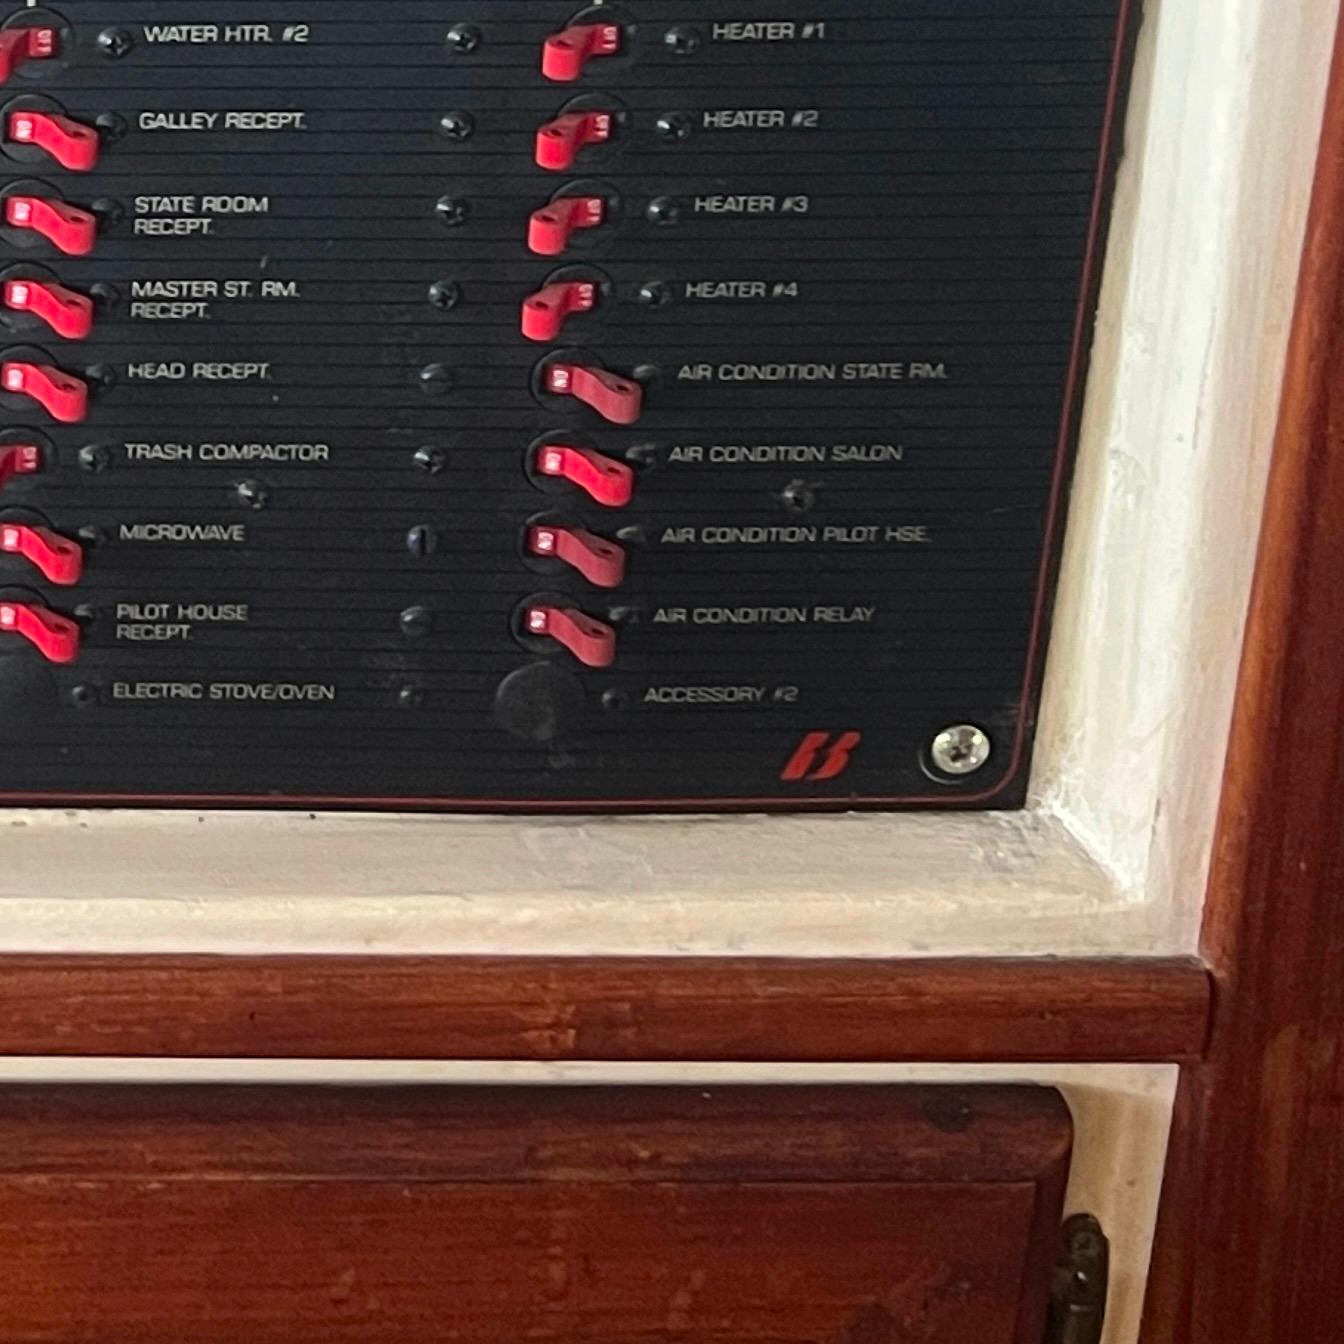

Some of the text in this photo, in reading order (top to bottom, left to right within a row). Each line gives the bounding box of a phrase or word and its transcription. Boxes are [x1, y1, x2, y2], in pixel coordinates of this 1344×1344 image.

[144, 25, 309, 43] WATER HTR. #2
[713, 22, 825, 40] HEATER #1
[140, 112, 306, 129] GALLEY RECEPT.
[704, 111, 818, 128] HEATER #2
[135, 196, 268, 214] STATE ROOM
[695, 196, 809, 213] HEATER #3
[134, 218, 213, 235] RECEPT.
[132, 281, 300, 297] MASTER ST. RM.
[685, 282, 798, 298] HEATER #4
[131, 302, 211, 319] RECEPT.
[128, 363, 272, 379] HEAD RECEPT.
[678, 364, 712, 381] AIR
[718, 363, 834, 381] CONDITION
[842, 363, 903, 380] STATE
[125, 444, 329, 461] TRASH COMPACTOR
[668, 444, 903, 463] AIR CONDITION SALON
[120, 525, 245, 542] MICROWAVE
[661, 527, 695, 543] AIR
[701, 526, 817, 543] CONDITION
[823, 525, 878, 542] PILOT
[117, 604, 247, 621] PILOT HOUSE
[653, 606, 875, 624] AIR CONDITION RELAY
[113, 683, 336, 701] ELECTRIC STOVE/OVEN
[644, 686, 799, 703] ACCESSORY #2
